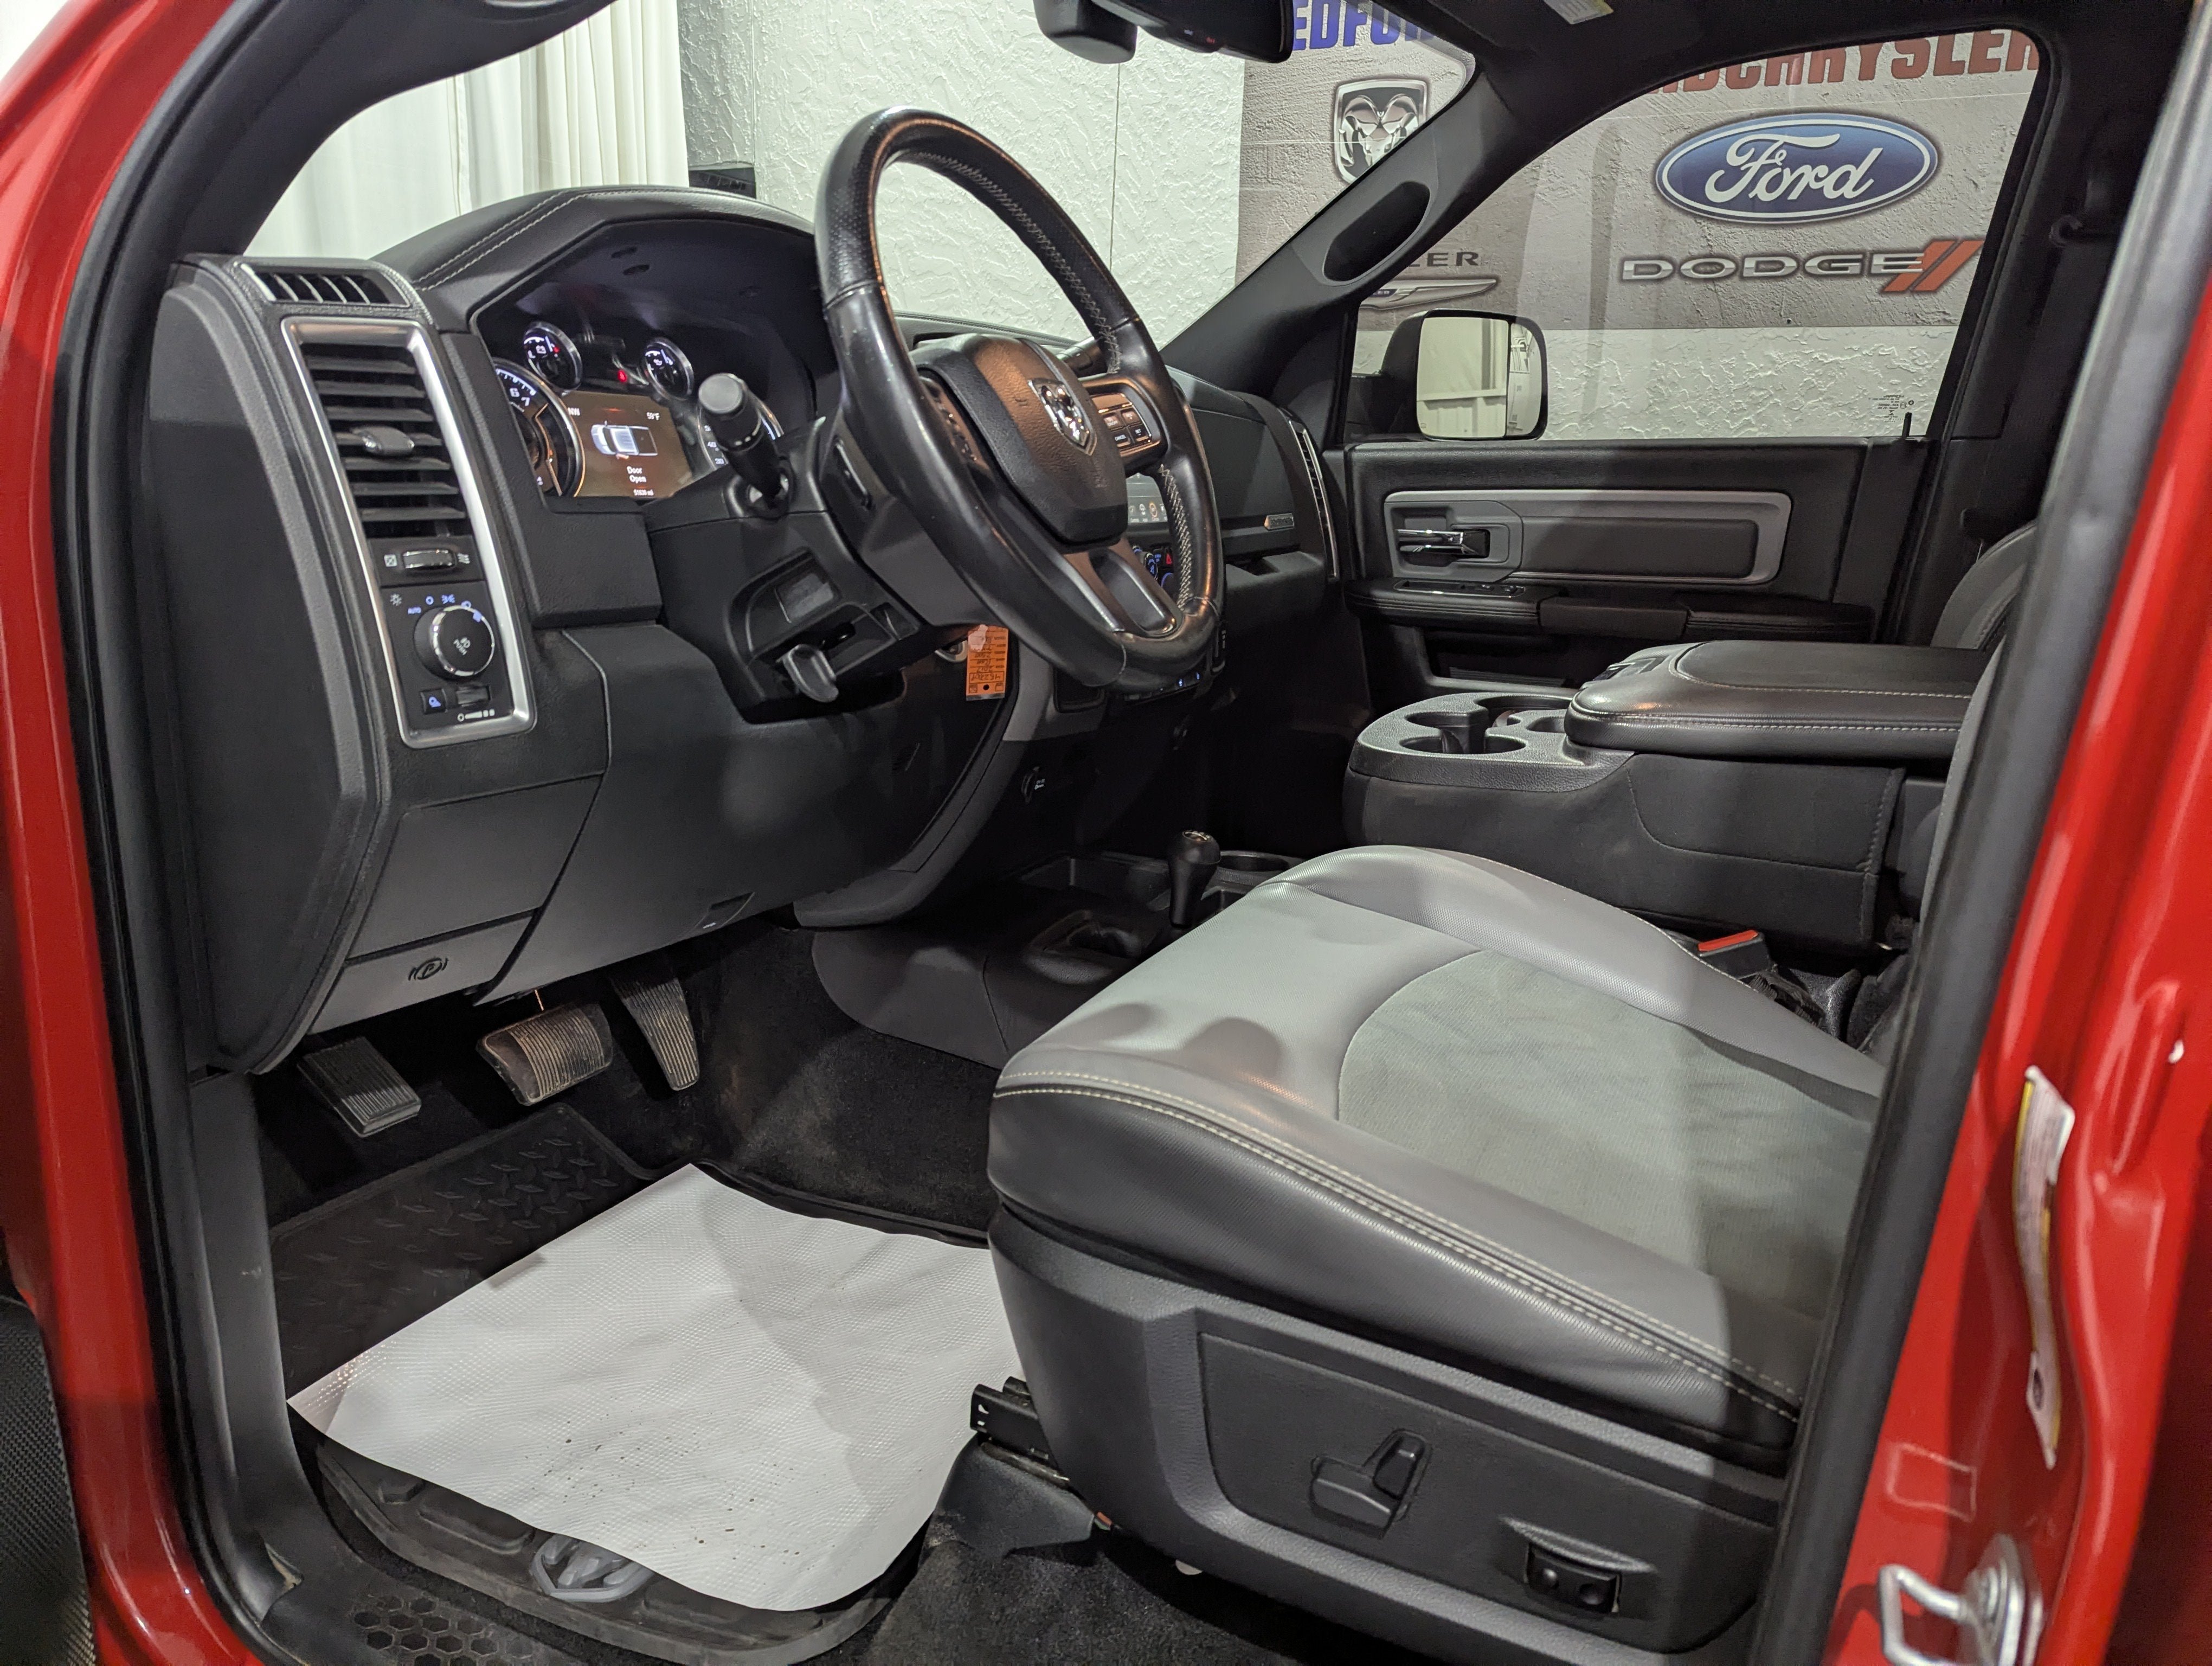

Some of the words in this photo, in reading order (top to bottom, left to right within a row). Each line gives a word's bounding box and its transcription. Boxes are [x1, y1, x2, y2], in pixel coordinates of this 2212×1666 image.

[1705, 133, 1883, 203] Ford
[1409, 252, 1479, 267] ER
[1622, 253, 1925, 280] DODGE
[510, 388, 520, 397] 6
[521, 397, 530, 406] 7
[626, 465, 642, 474] Door
[629, 475, 647, 484] Open
